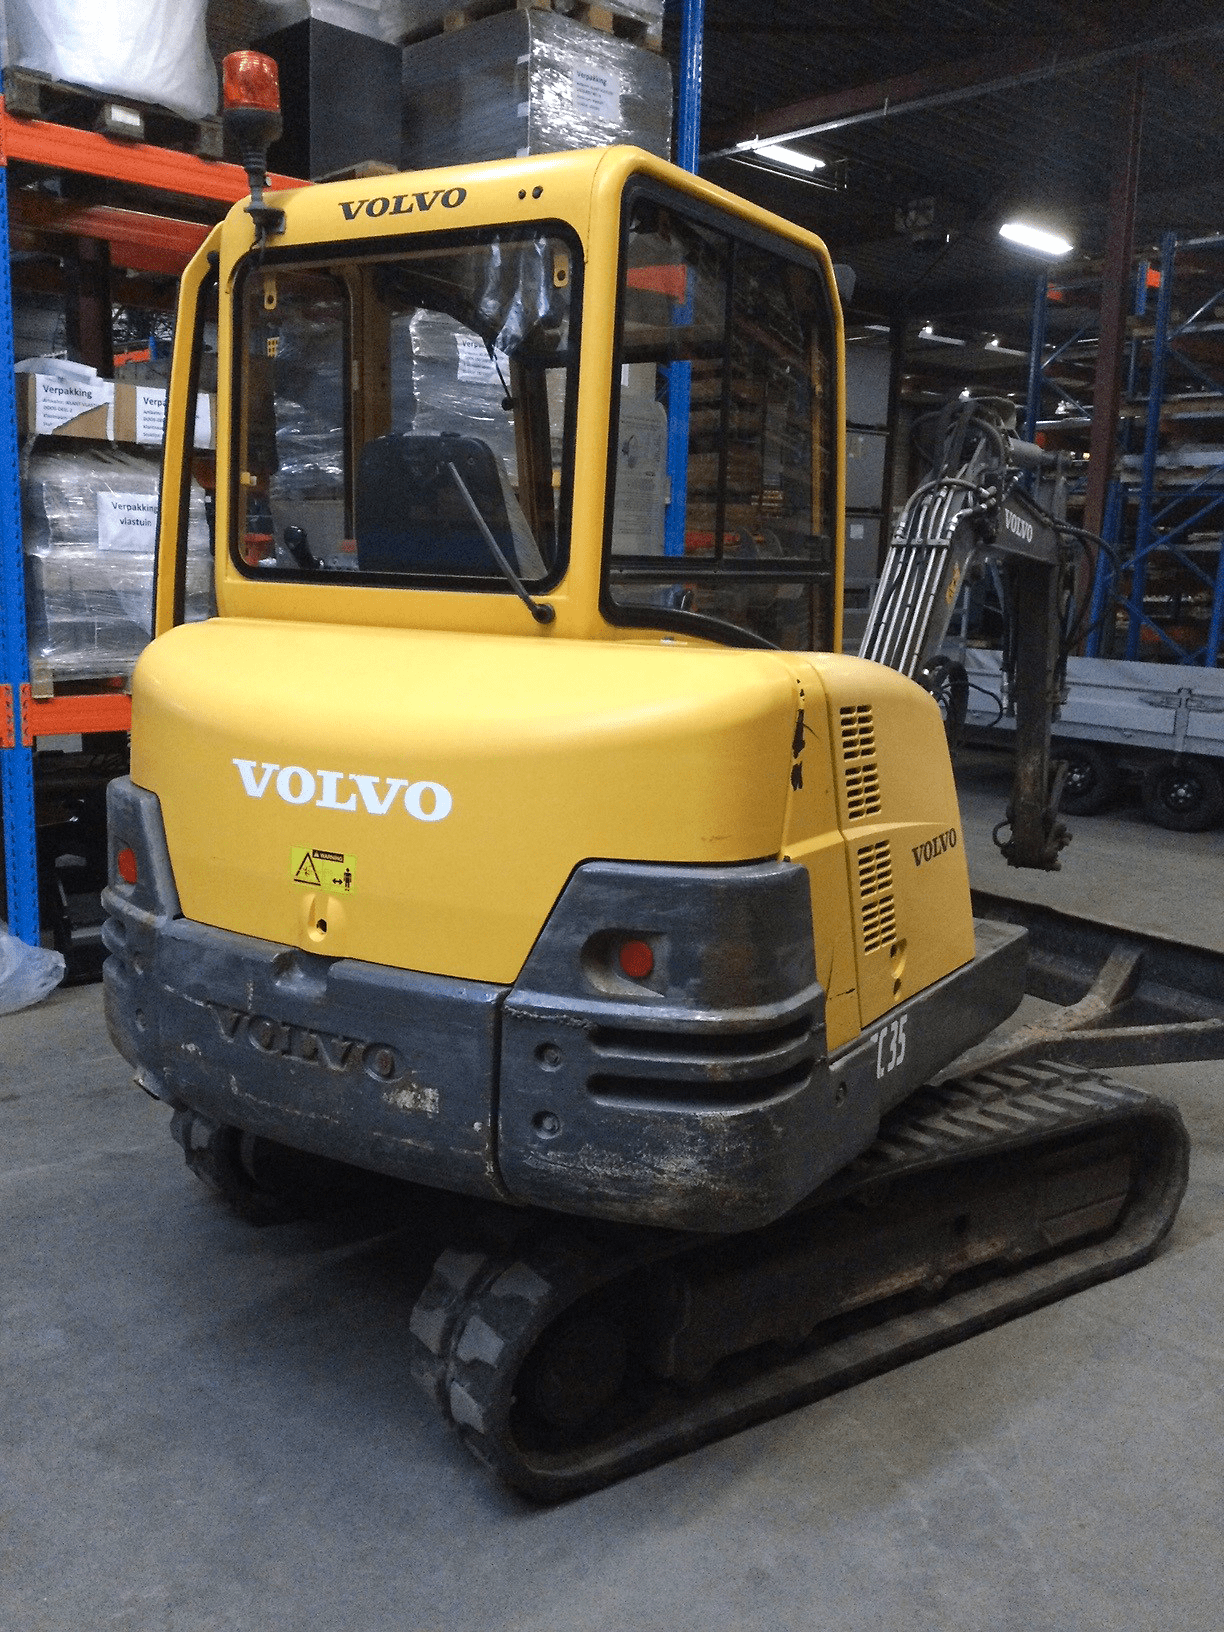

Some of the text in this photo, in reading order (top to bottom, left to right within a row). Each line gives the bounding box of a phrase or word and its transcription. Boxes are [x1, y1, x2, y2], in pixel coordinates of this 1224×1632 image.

[338, 187, 467, 220] VOLVO
[42, 384, 93, 400] Verpakking
[111, 501, 158, 514] Verpakking
[1005, 508, 1033, 542] VOLVO
[232, 758, 453, 822] VOLVO
[912, 828, 956, 866] VOLVO
[205, 1000, 402, 1084] VOLVO
